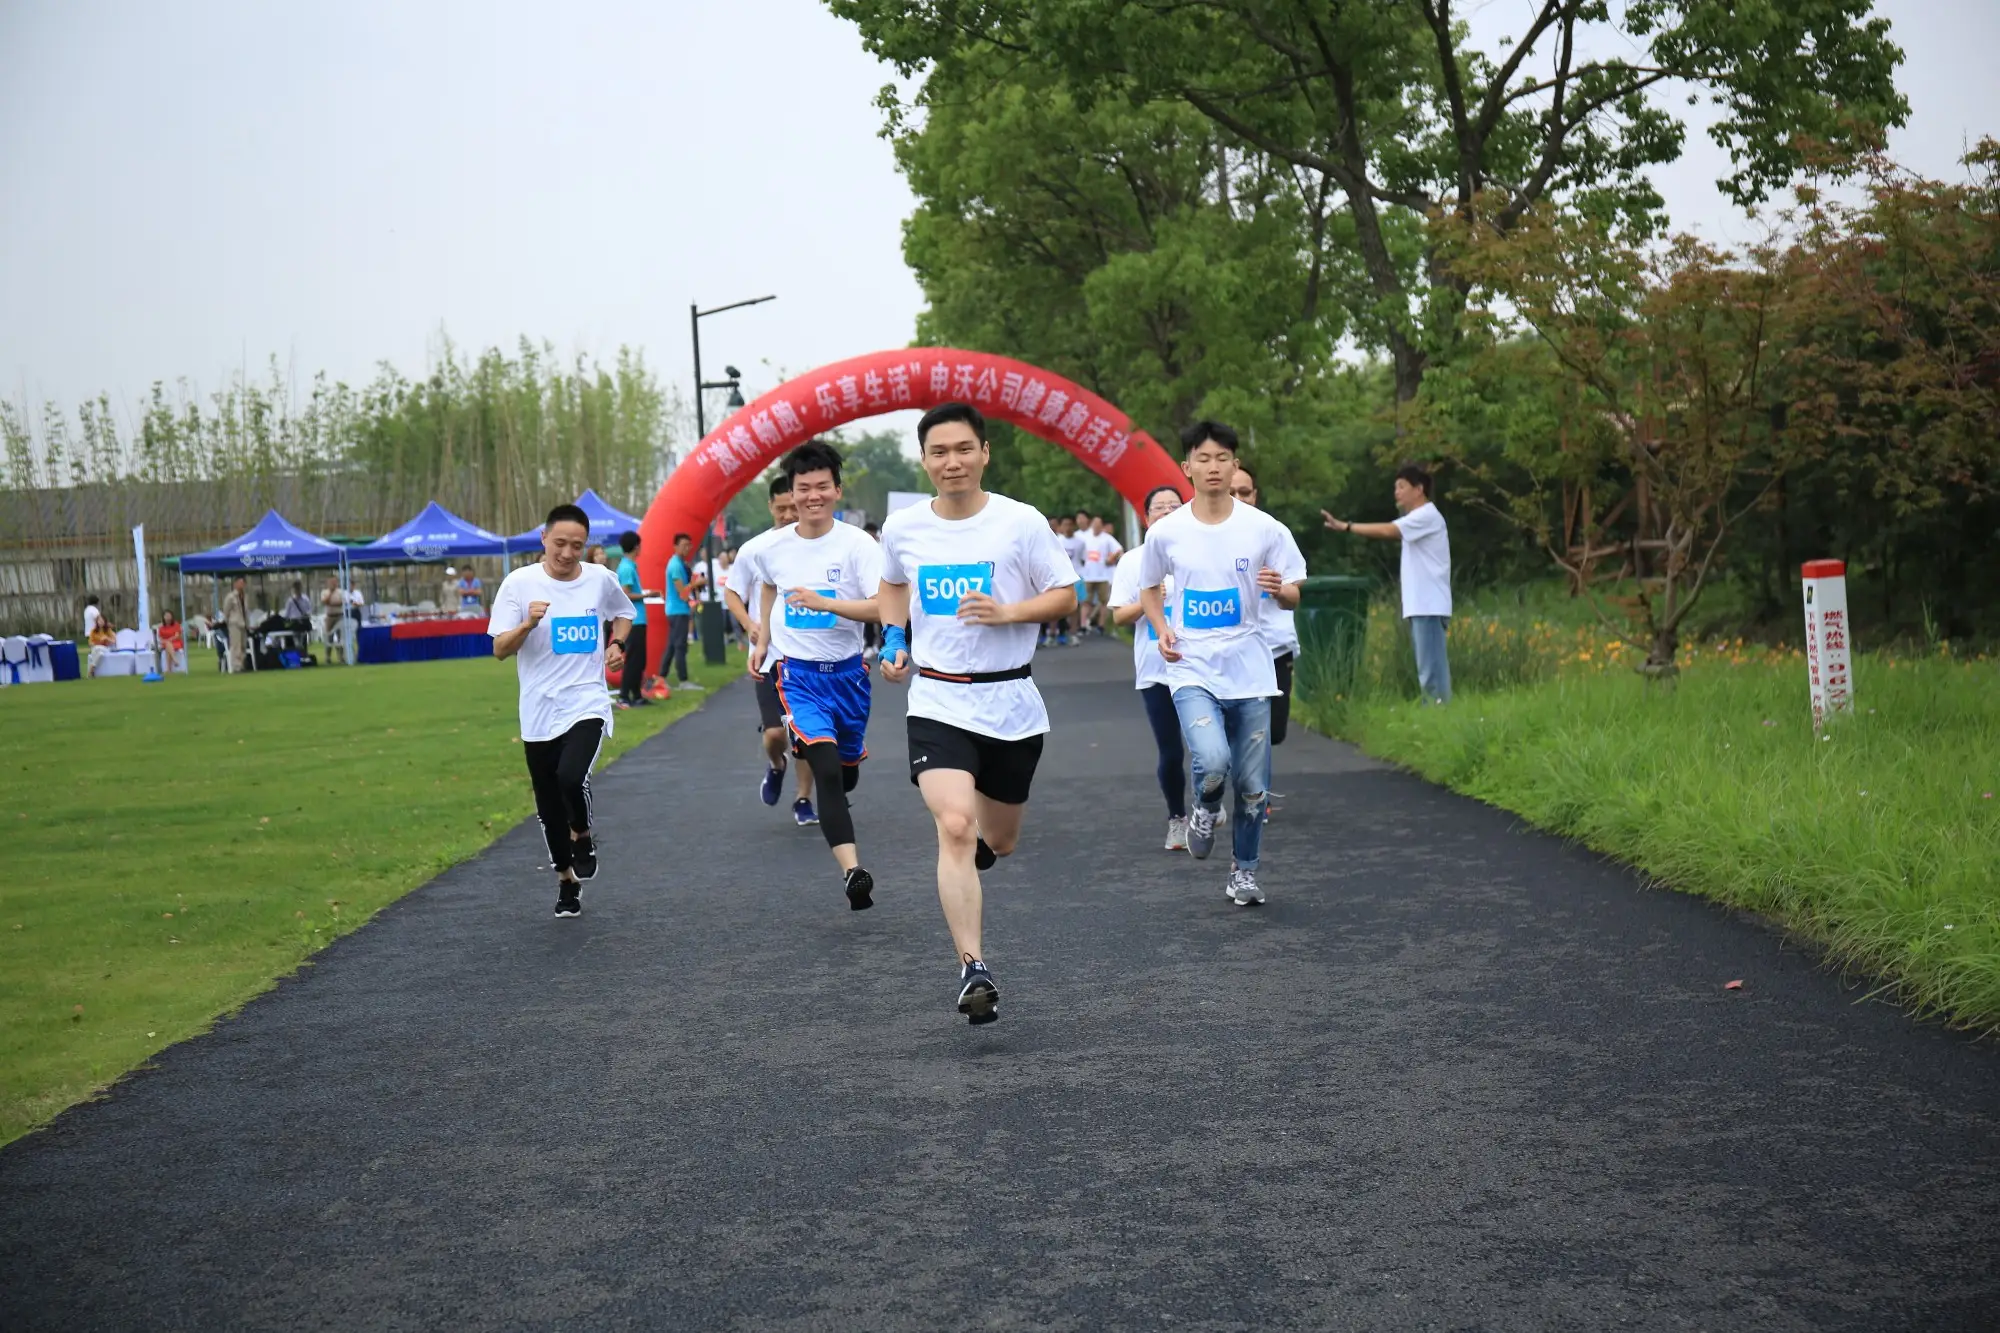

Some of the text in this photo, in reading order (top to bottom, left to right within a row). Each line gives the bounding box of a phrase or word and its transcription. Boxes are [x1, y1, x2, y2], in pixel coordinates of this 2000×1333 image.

[925, 577, 984, 600] 5007
[1188, 598, 1235, 617] 5004
[557, 625, 597, 642] 5001
[819, 663, 835, 673] OKC
